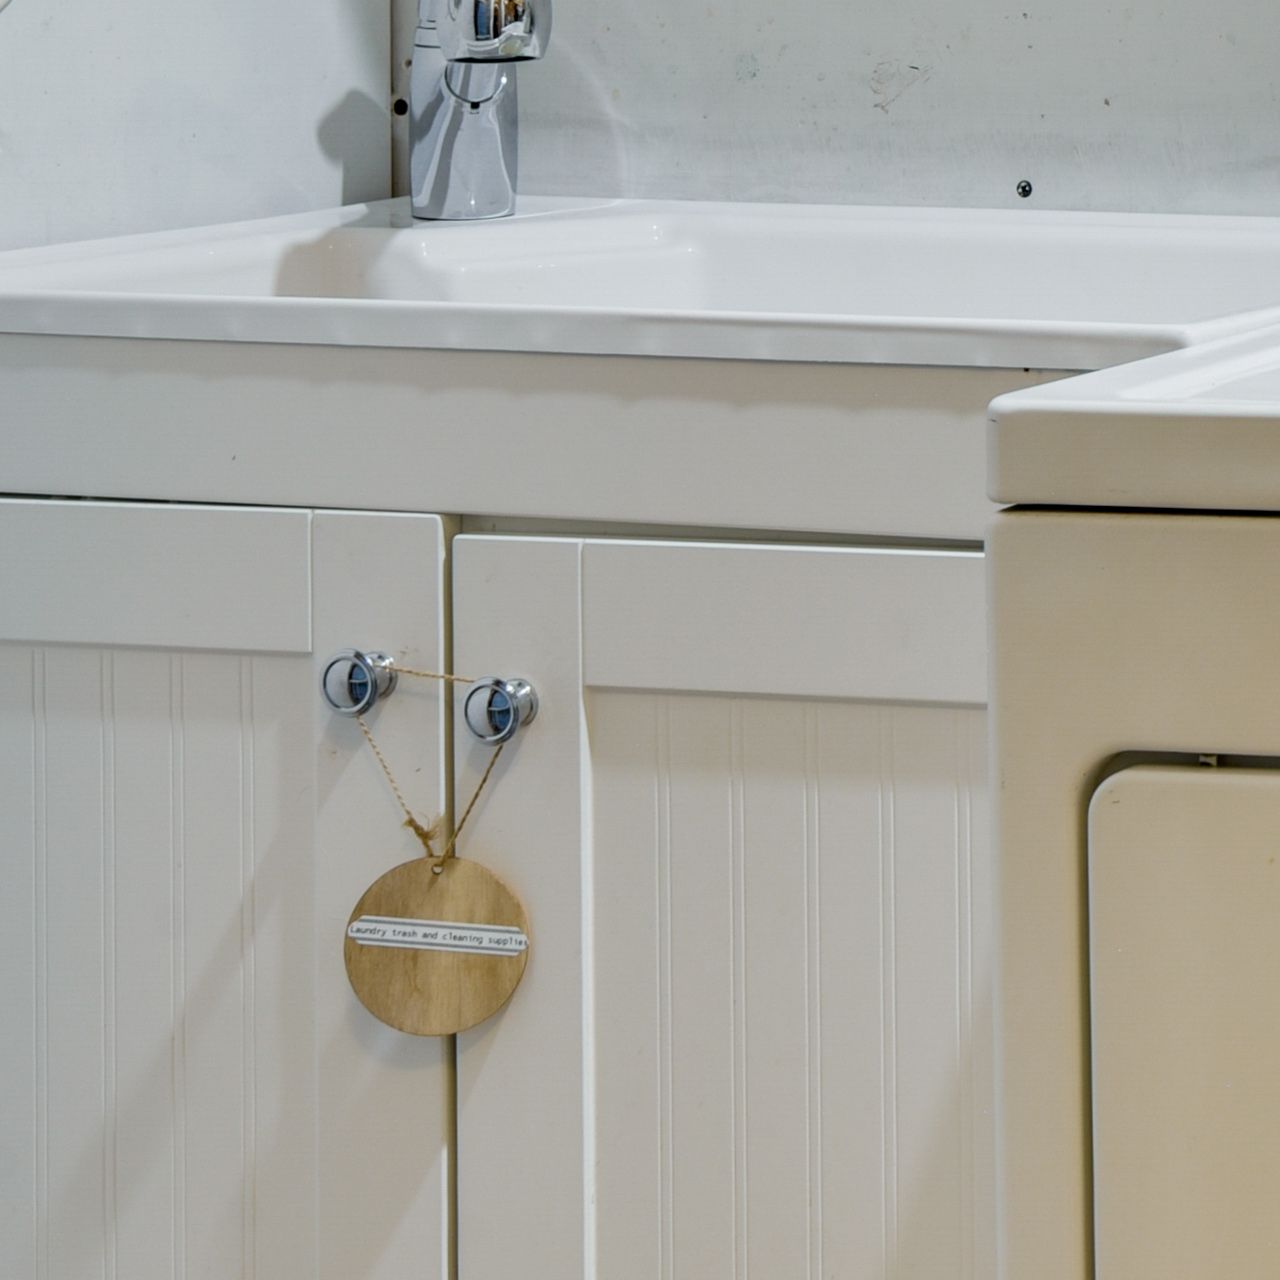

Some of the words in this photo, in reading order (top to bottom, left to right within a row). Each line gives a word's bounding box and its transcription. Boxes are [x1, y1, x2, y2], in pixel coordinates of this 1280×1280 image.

[350, 925, 387, 937] Laundry
[392, 928, 418, 937] trash
[422, 931, 438, 940] and
[442, 933, 483, 945] cleaning
